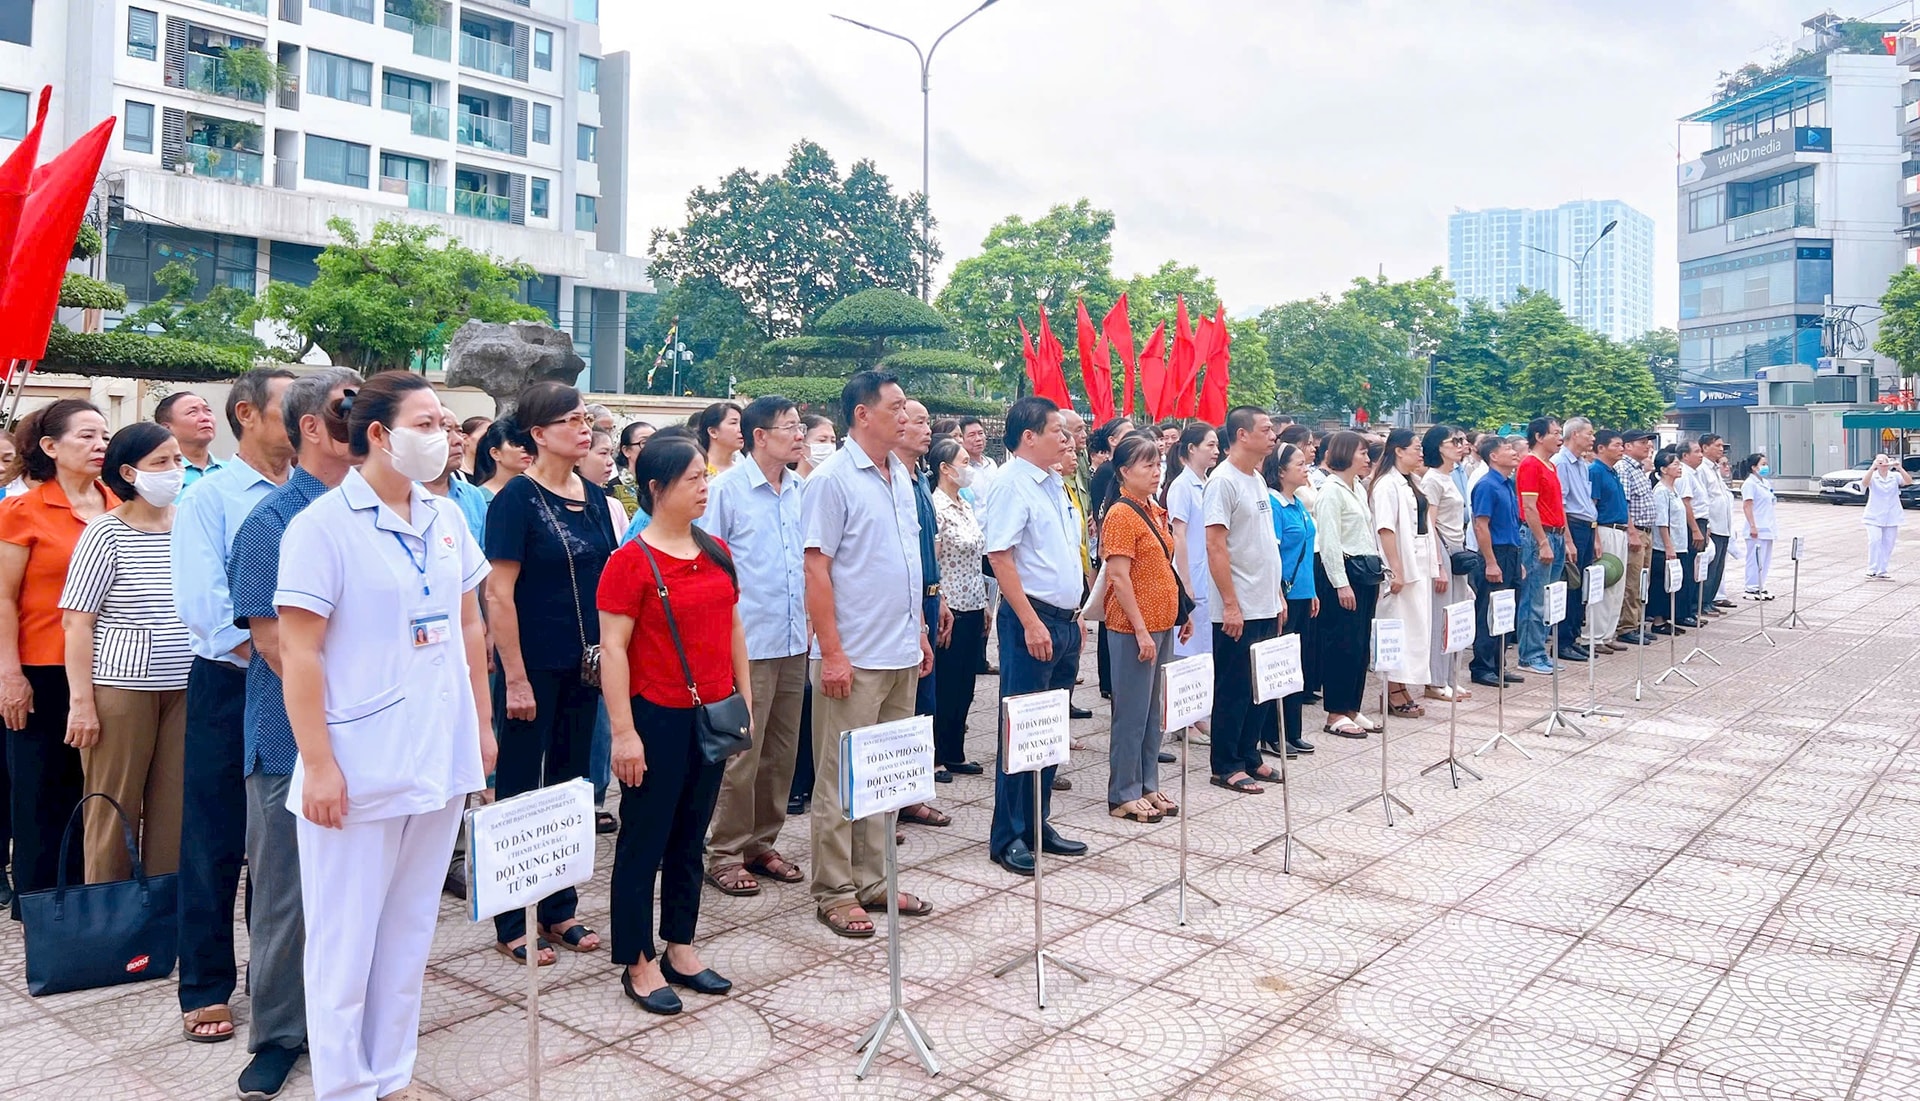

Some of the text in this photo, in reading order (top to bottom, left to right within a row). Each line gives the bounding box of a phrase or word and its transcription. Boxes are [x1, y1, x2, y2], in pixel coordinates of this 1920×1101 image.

[1717, 139, 1782, 169] WIND media
[866, 743, 929, 765] TỔ DÂN PHỐ SỐ 1
[866, 765, 926, 790] ĐỘI XUNG KÍCH
[874, 781, 917, 800] TỪ 75 79
[494, 813, 583, 852] TỔ DÂN PHỐ SỐ 2
[495, 842, 580, 883] ĐỘI XUNG KÍCH
[507, 863, 567, 895] TỪ 80 83
